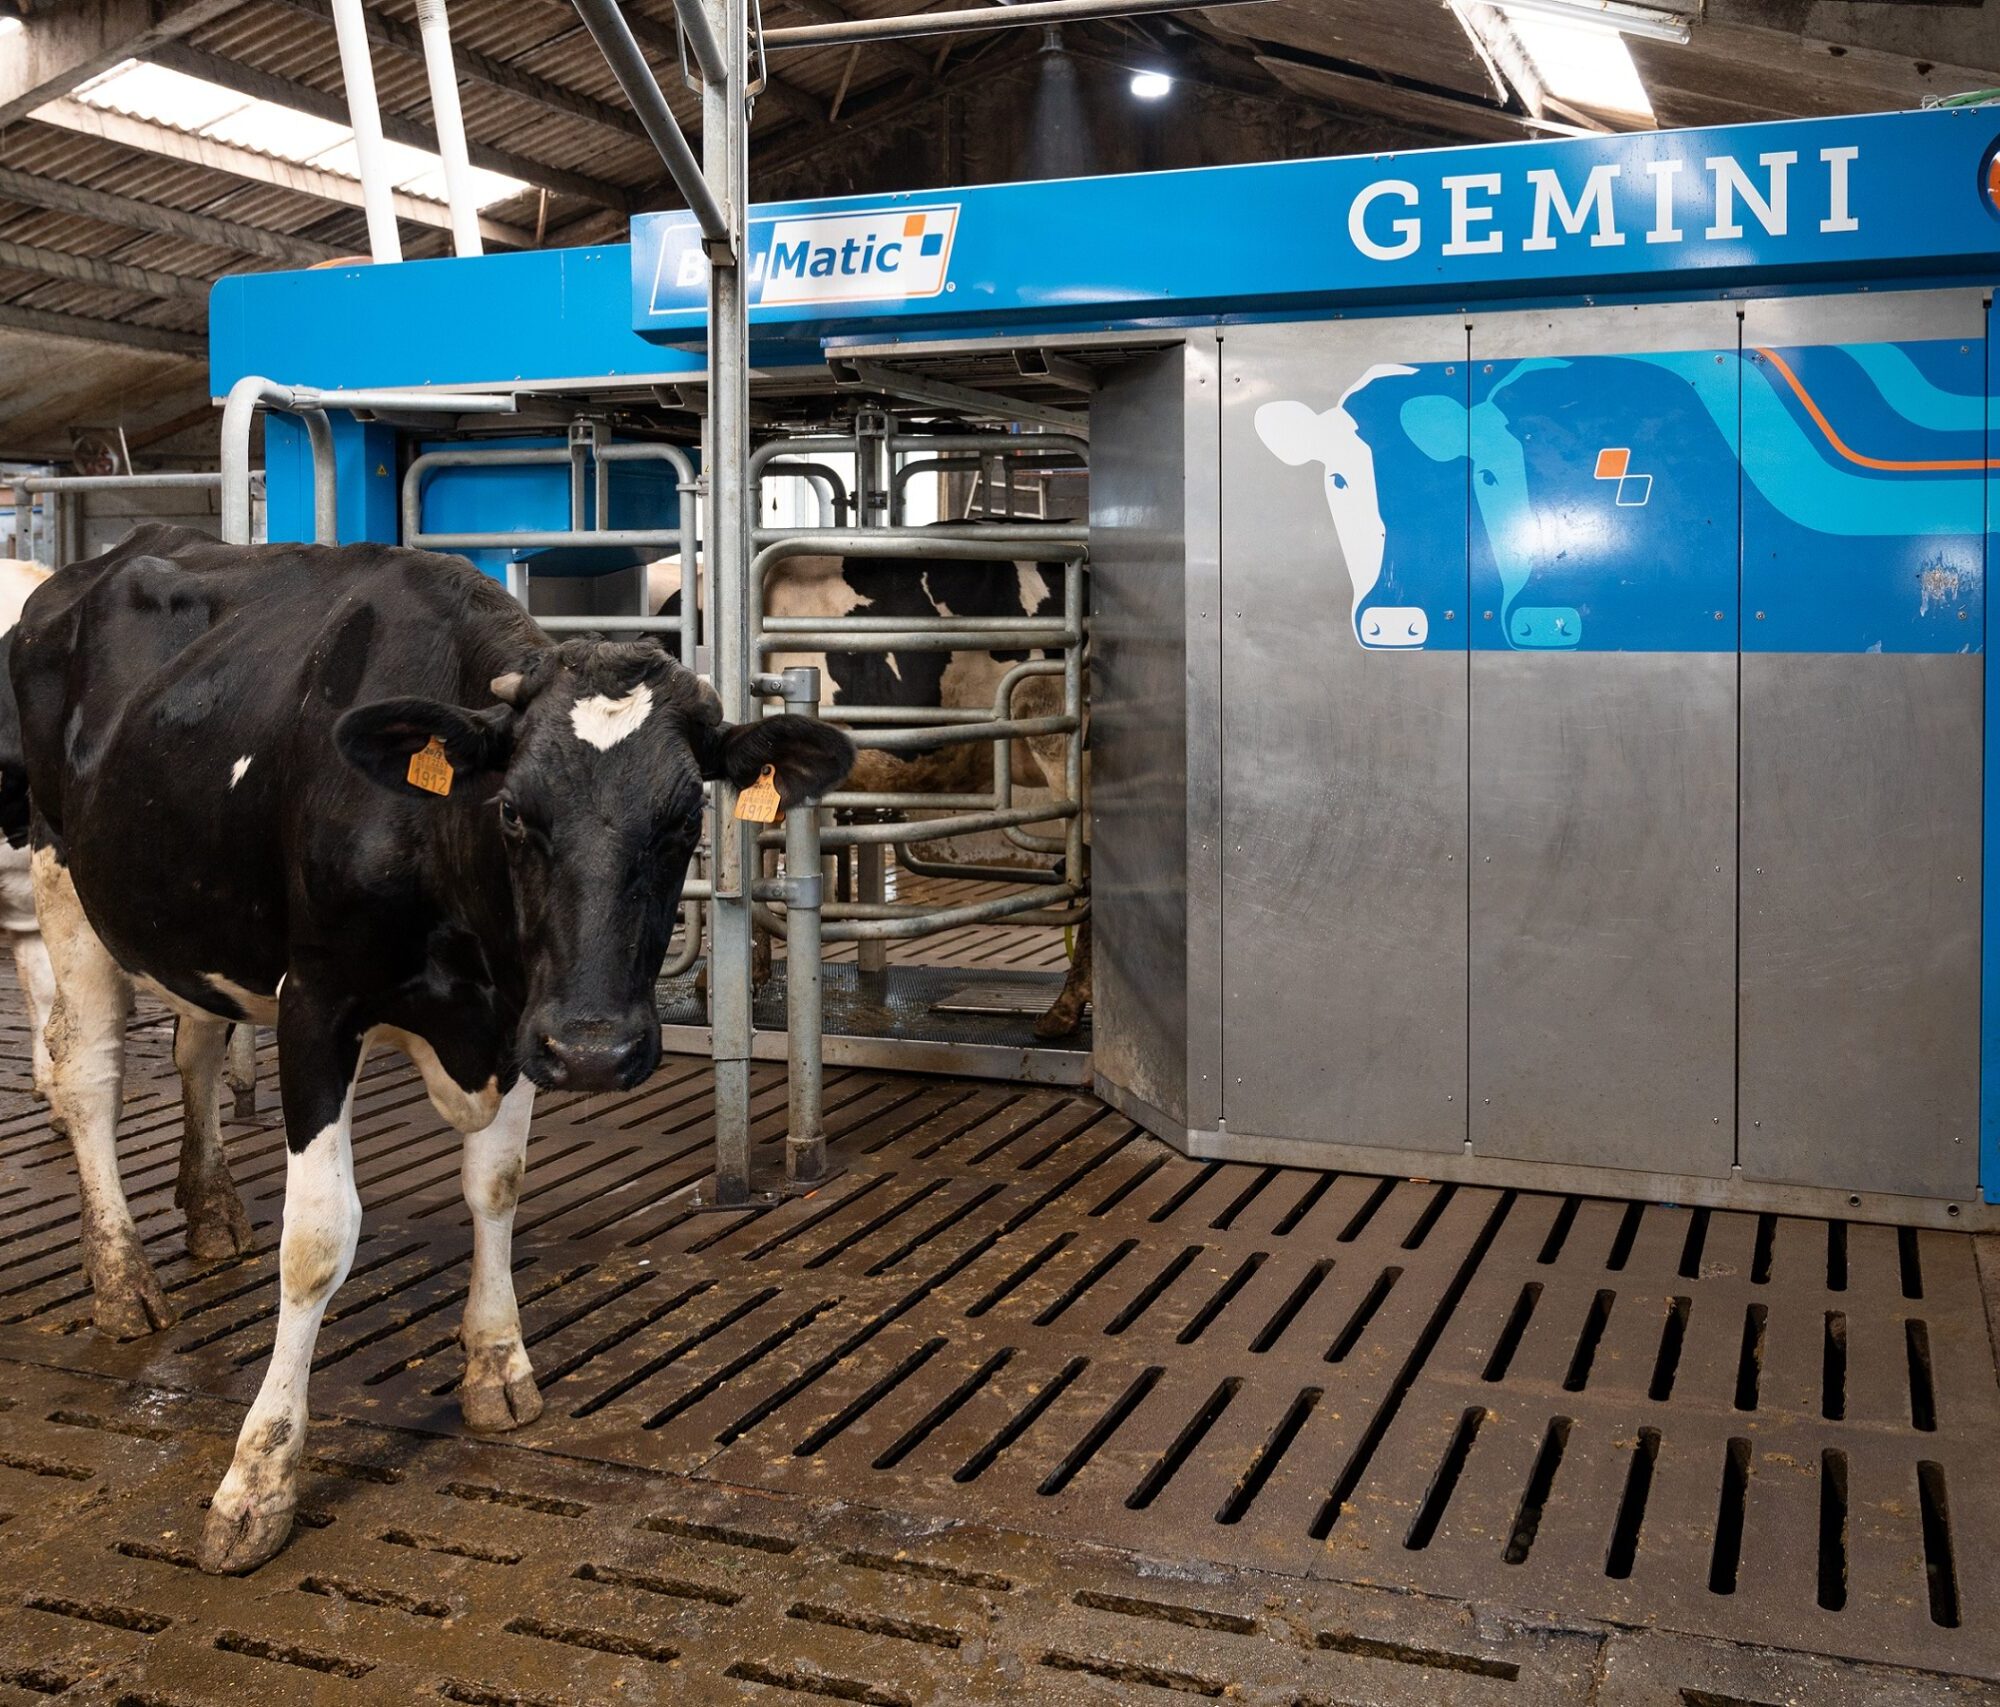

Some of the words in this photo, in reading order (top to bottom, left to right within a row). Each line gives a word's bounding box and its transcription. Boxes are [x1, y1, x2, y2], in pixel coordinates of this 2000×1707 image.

[1348, 146, 1859, 261] GEMINI
[676, 234, 902, 288] BuMatic
[414, 767, 447, 794] 1912
